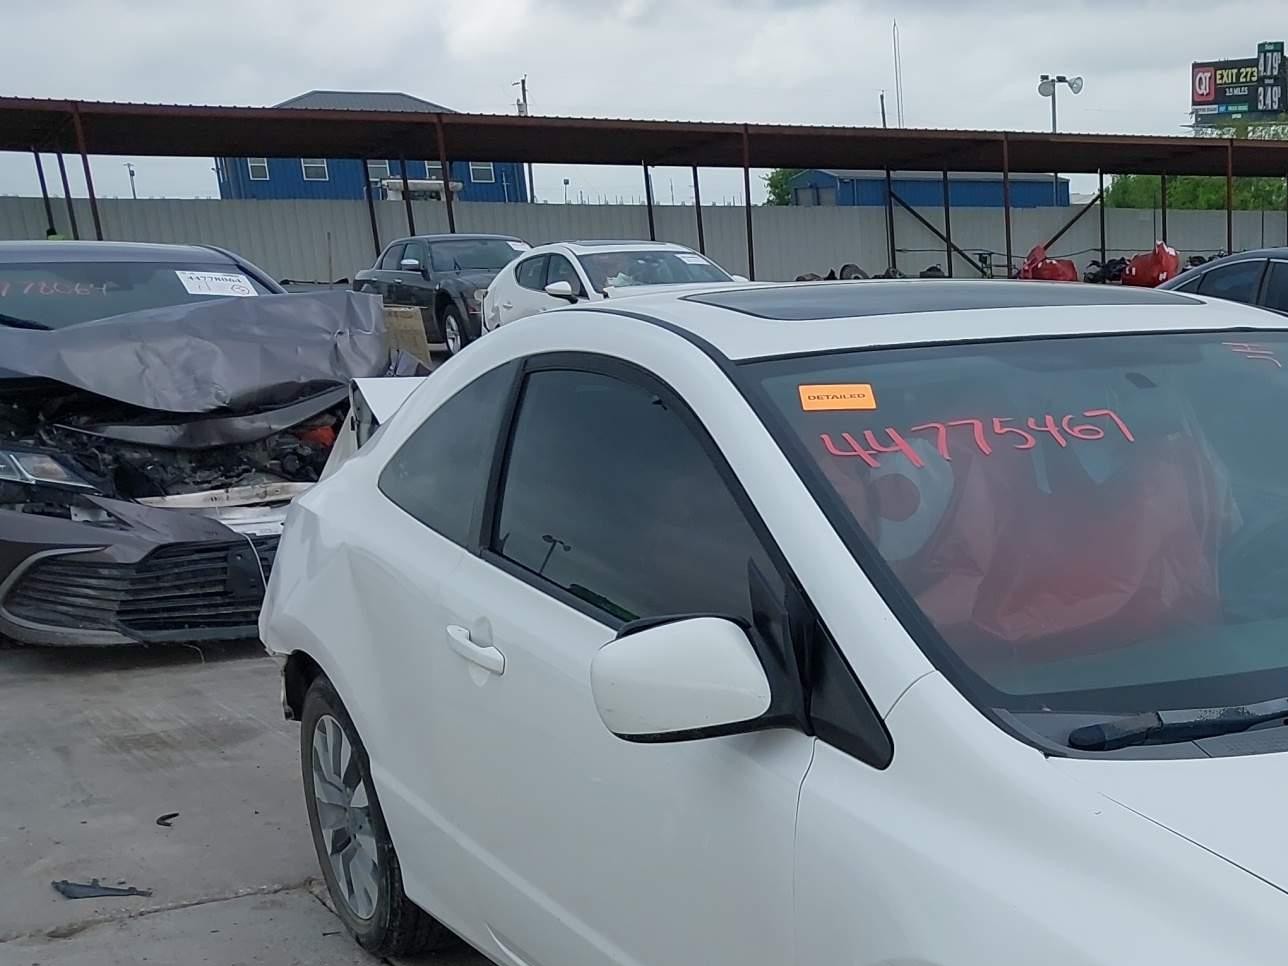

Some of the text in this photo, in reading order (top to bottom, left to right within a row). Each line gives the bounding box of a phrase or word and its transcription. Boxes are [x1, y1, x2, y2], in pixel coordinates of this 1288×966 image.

[1196, 72, 1211, 95] QT
[1216, 67, 1257, 84] EXIT 273
[807, 392, 867, 402] DETAILED
[820, 409, 1136, 468] 44775467
